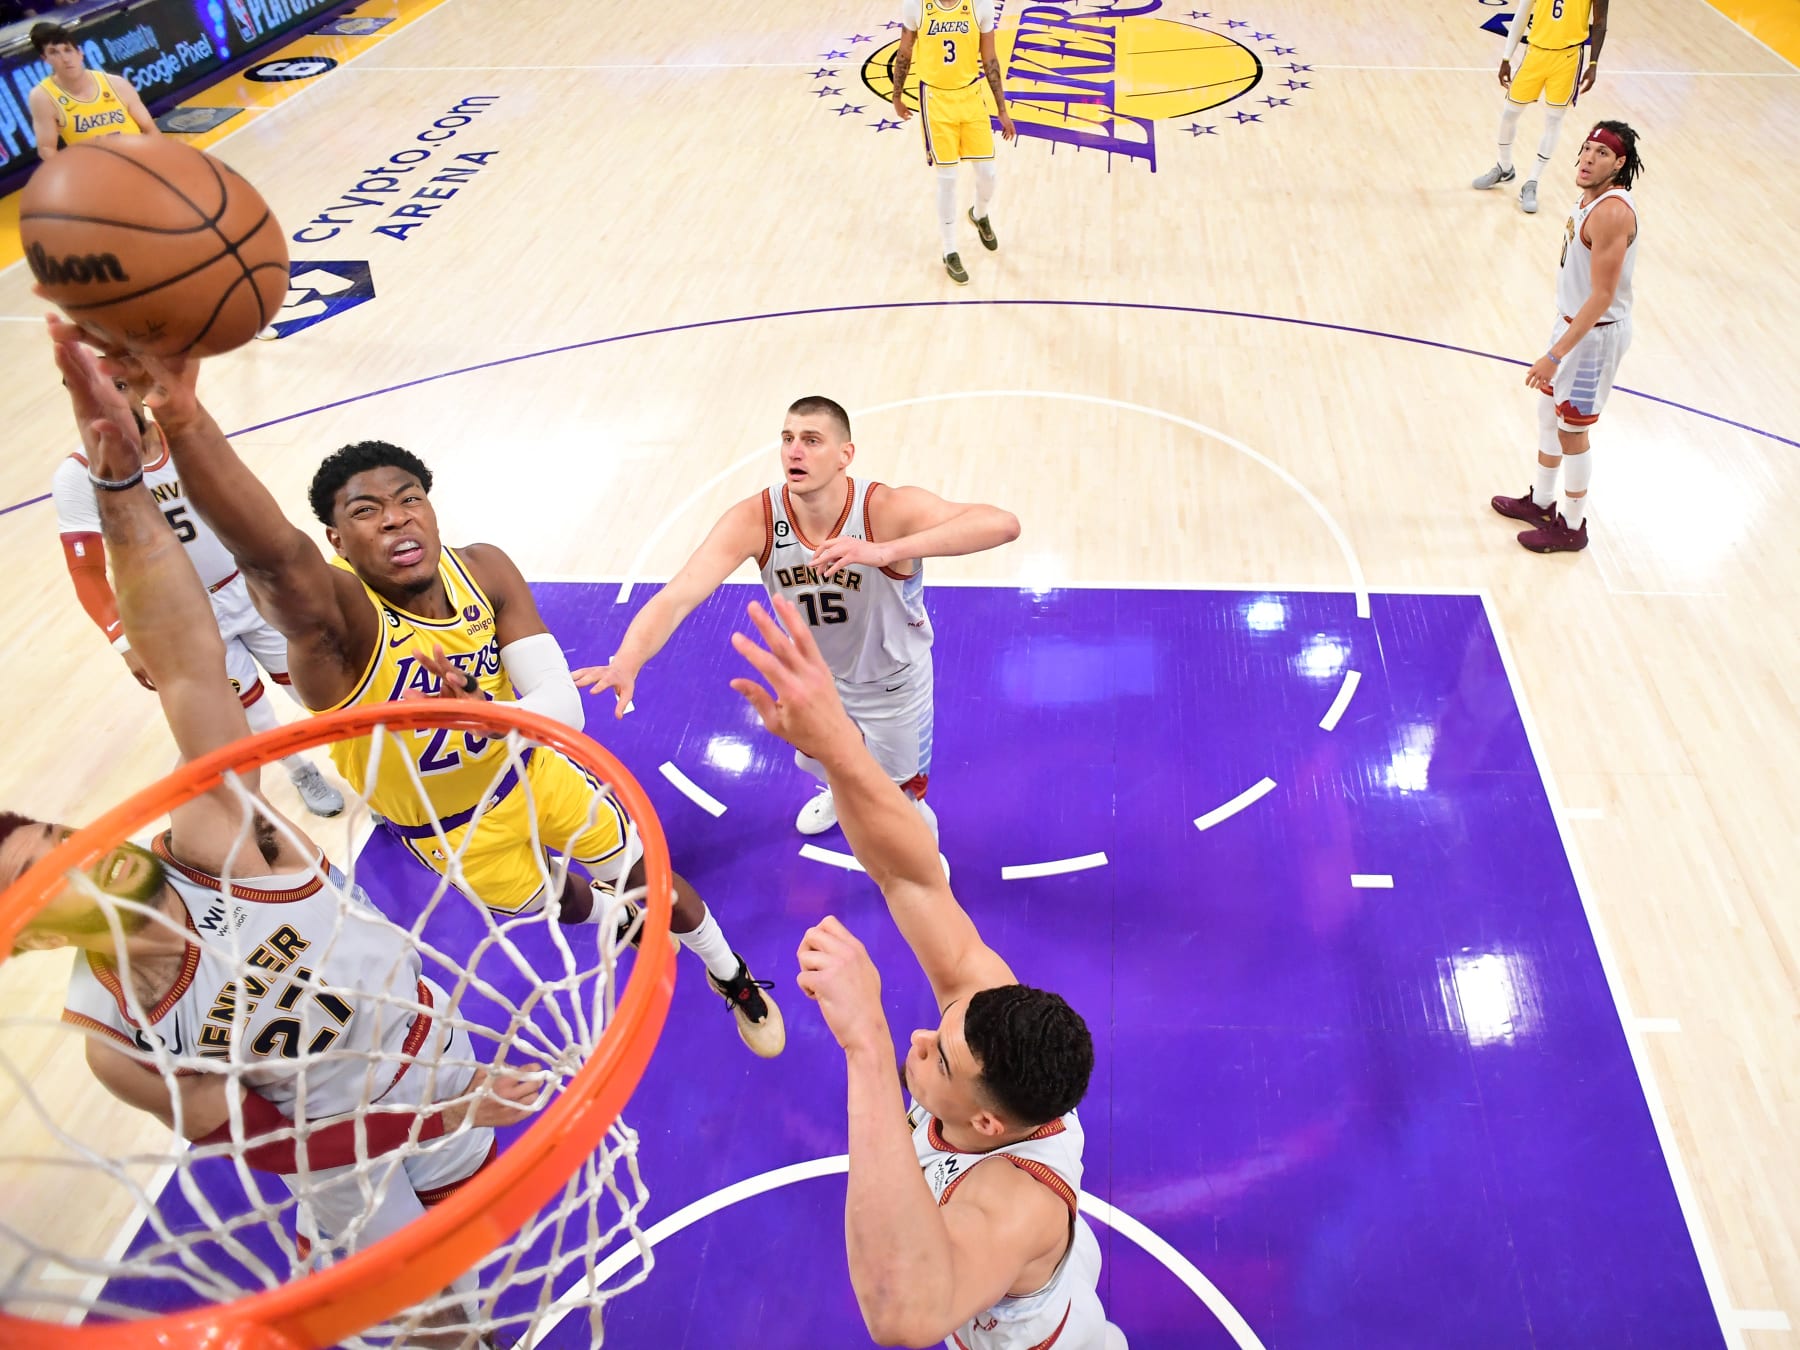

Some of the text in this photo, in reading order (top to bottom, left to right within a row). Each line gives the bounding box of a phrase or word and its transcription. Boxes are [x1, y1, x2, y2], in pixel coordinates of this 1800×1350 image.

[1552, 0, 1564, 19] 6
[926, 19, 970, 36] LAKERS
[122, 51, 181, 92] Google
[175, 33, 214, 67] Pixel
[943, 40, 956, 63] 3
[73, 109, 126, 133] LAKERS
[292, 95, 501, 243] crypto.com
[370, 150, 500, 242] ARENA
[777, 523, 787, 535] 6
[797, 591, 848, 626] 15
[251, 966, 355, 1060] 27
